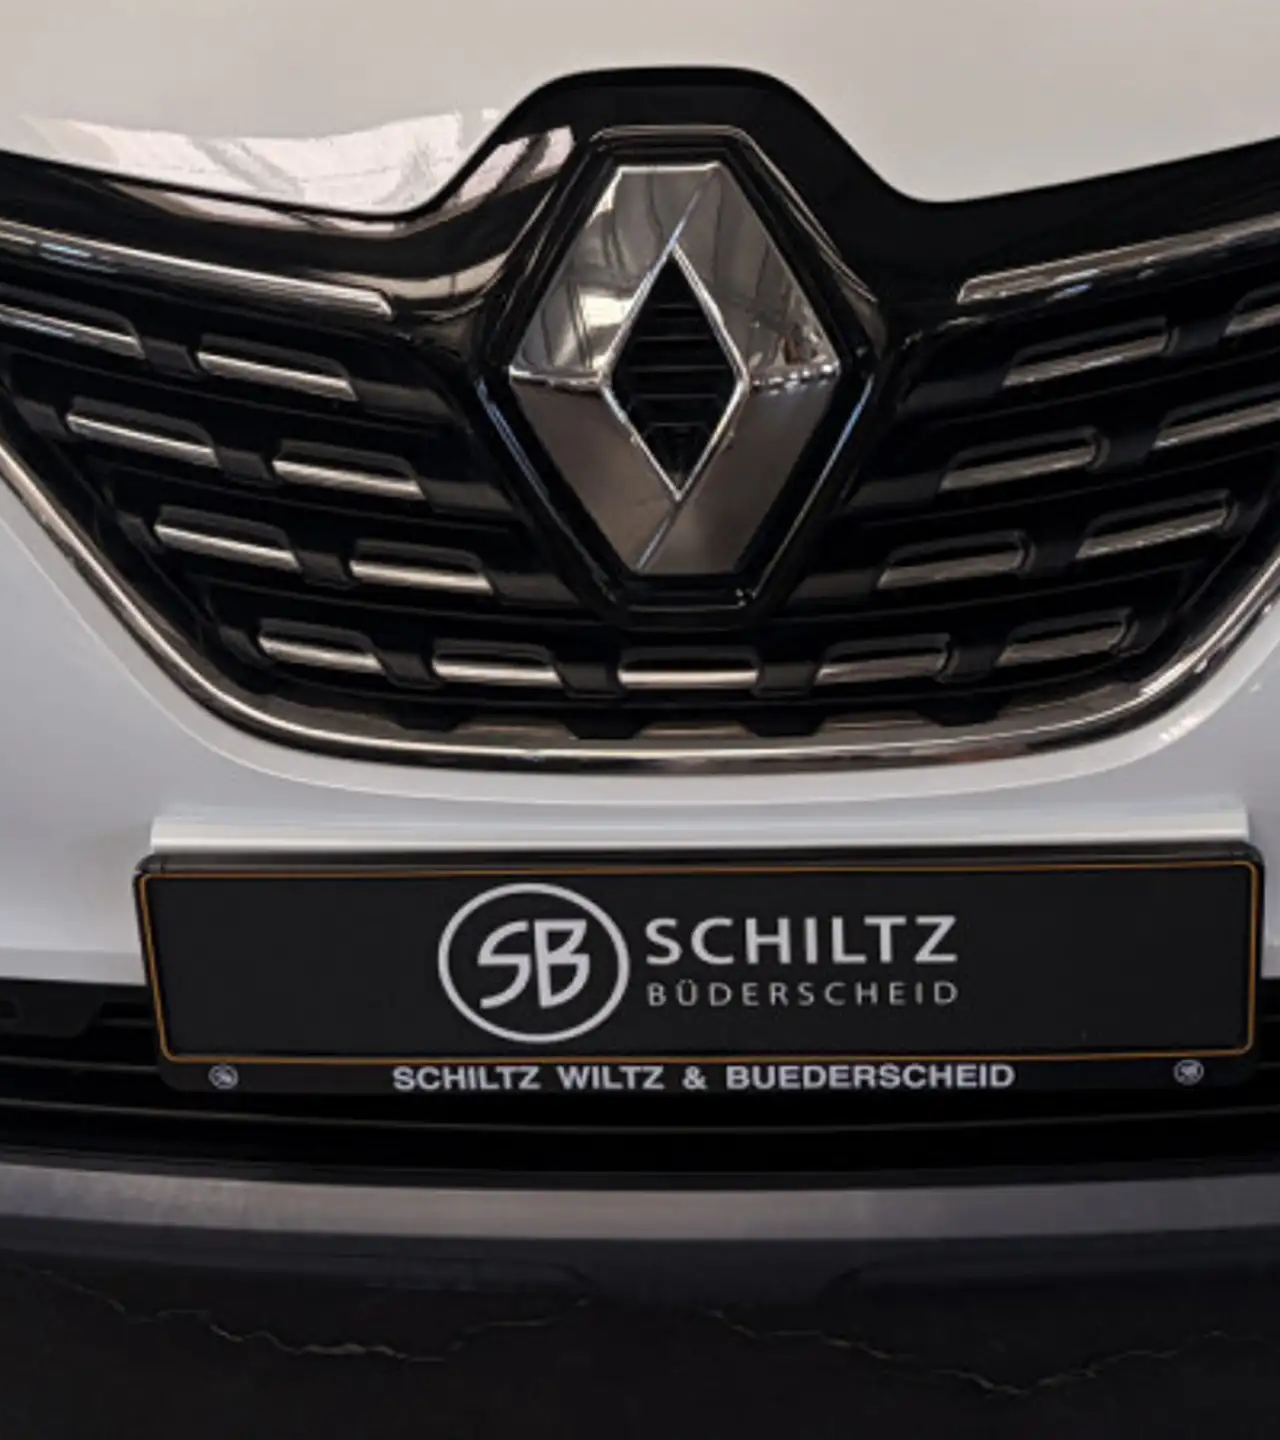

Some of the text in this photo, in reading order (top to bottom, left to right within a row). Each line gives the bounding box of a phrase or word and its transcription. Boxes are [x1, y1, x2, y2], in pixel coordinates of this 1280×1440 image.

[644, 914, 959, 966] SCHILTZ
[646, 978, 960, 1007] BÜDERSCHEID
[391, 1063, 1016, 1091] SCHILTZ WILTZ & BUEDERSCHEID
